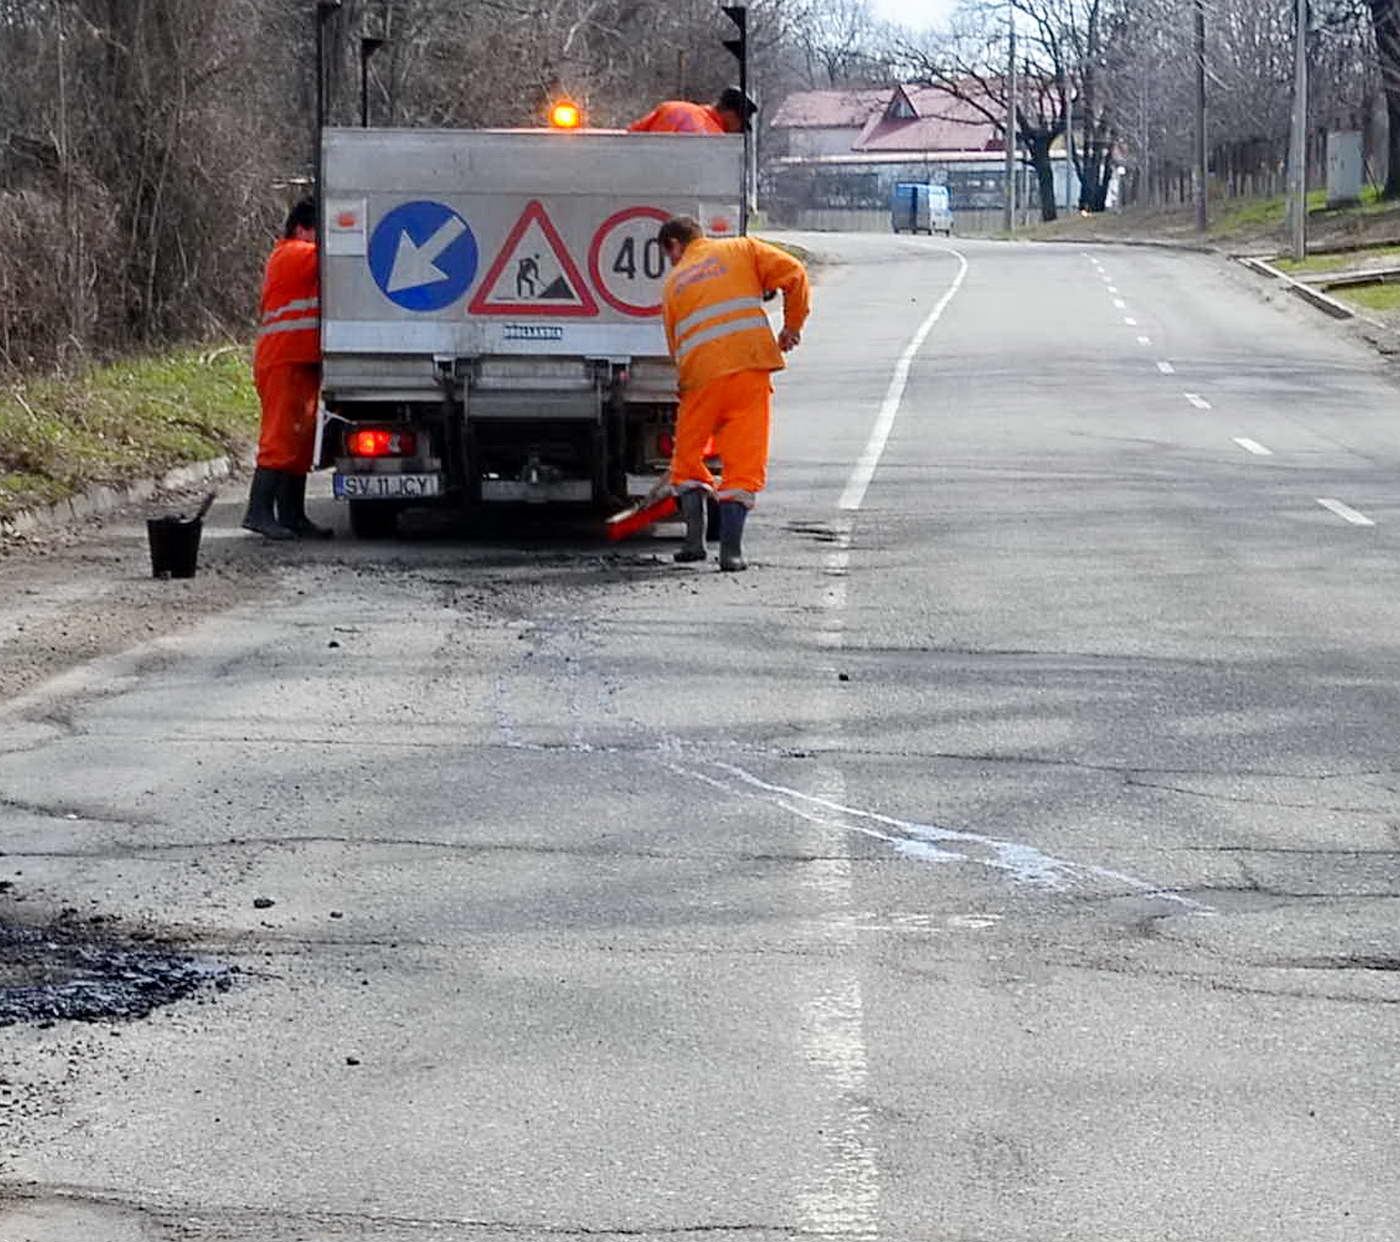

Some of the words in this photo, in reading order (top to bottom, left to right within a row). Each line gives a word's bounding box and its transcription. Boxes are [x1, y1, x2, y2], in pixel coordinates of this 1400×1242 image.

[612, 236, 665, 279] 40
[345, 475, 369, 495] SV
[378, 477, 389, 496] 11
